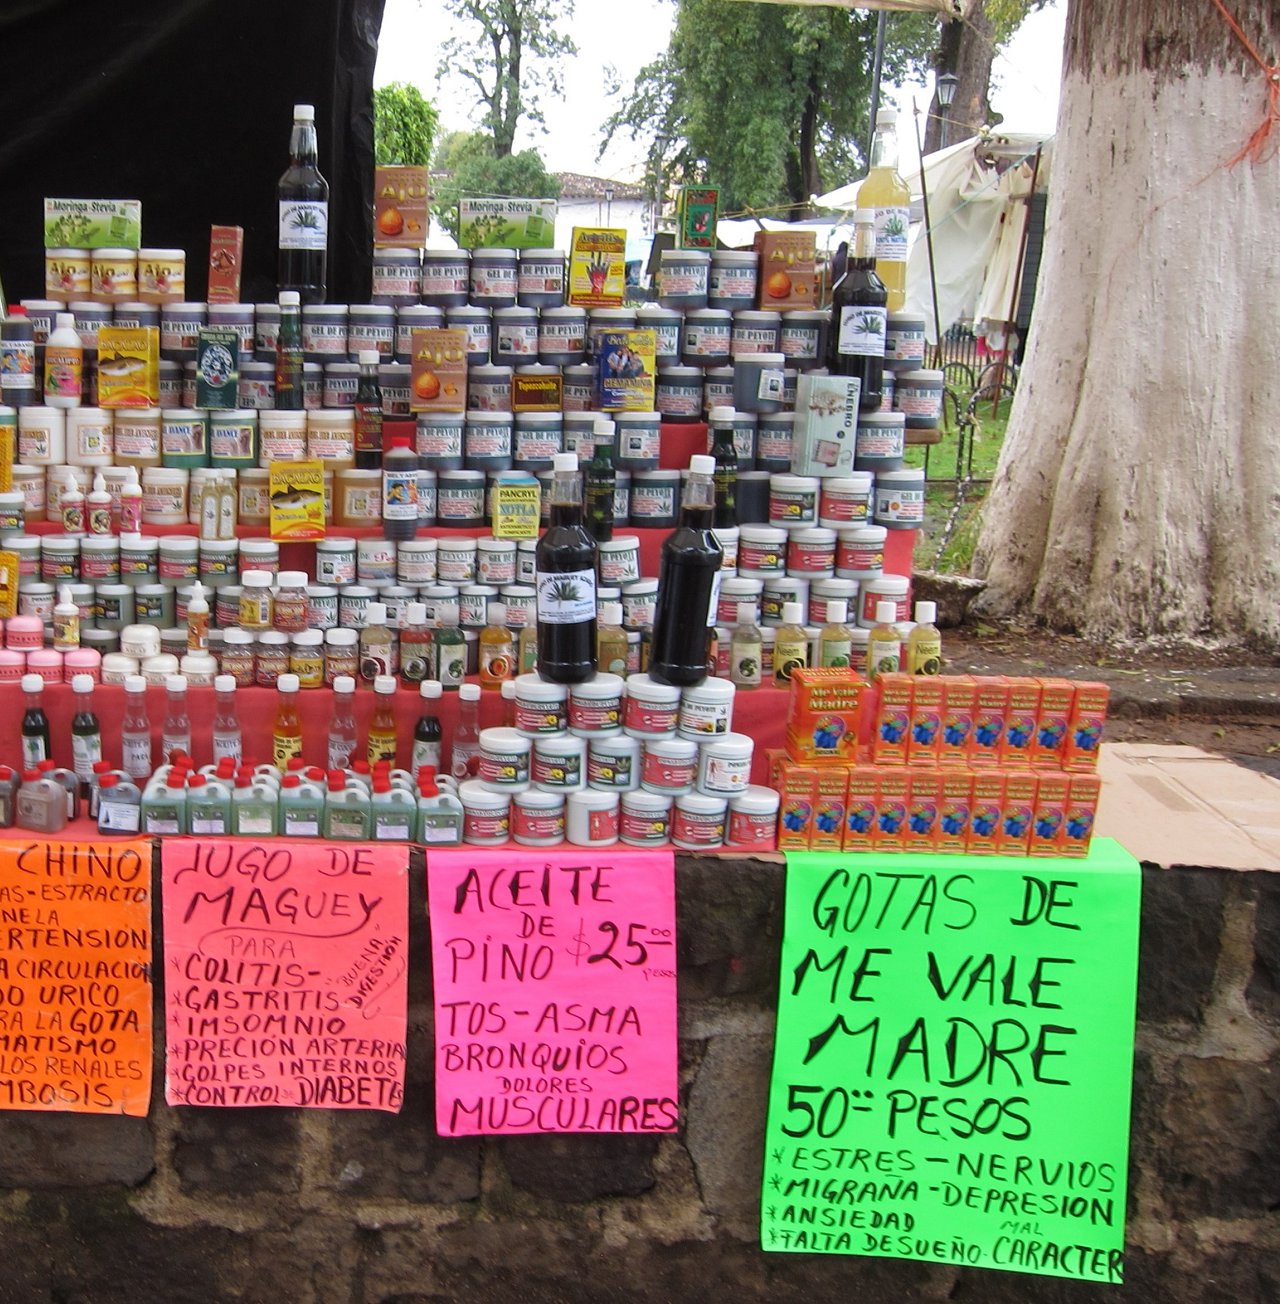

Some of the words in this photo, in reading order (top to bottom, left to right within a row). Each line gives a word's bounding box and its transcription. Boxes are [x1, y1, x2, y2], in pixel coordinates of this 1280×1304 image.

[53, 200, 87, 213] Moringa
[92, 201, 116, 213] Stevia
[470, 201, 503, 214] Moringa
[508, 201, 532, 212] Stevia
[17, 844, 142, 880] CHINO
[173, 845, 293, 884] JUGO
[183, 888, 383, 930] MAGUEY
[813, 868, 977, 938] GOTAS
[927, 951, 1076, 1009] VALE
[442, 1038, 628, 1074] BRONQUIOS
[803, 1014, 1077, 1087] MADRE
[450, 1096, 680, 1133] MUSCULARES
[781, 1205, 915, 1232] ANSIEDAD
